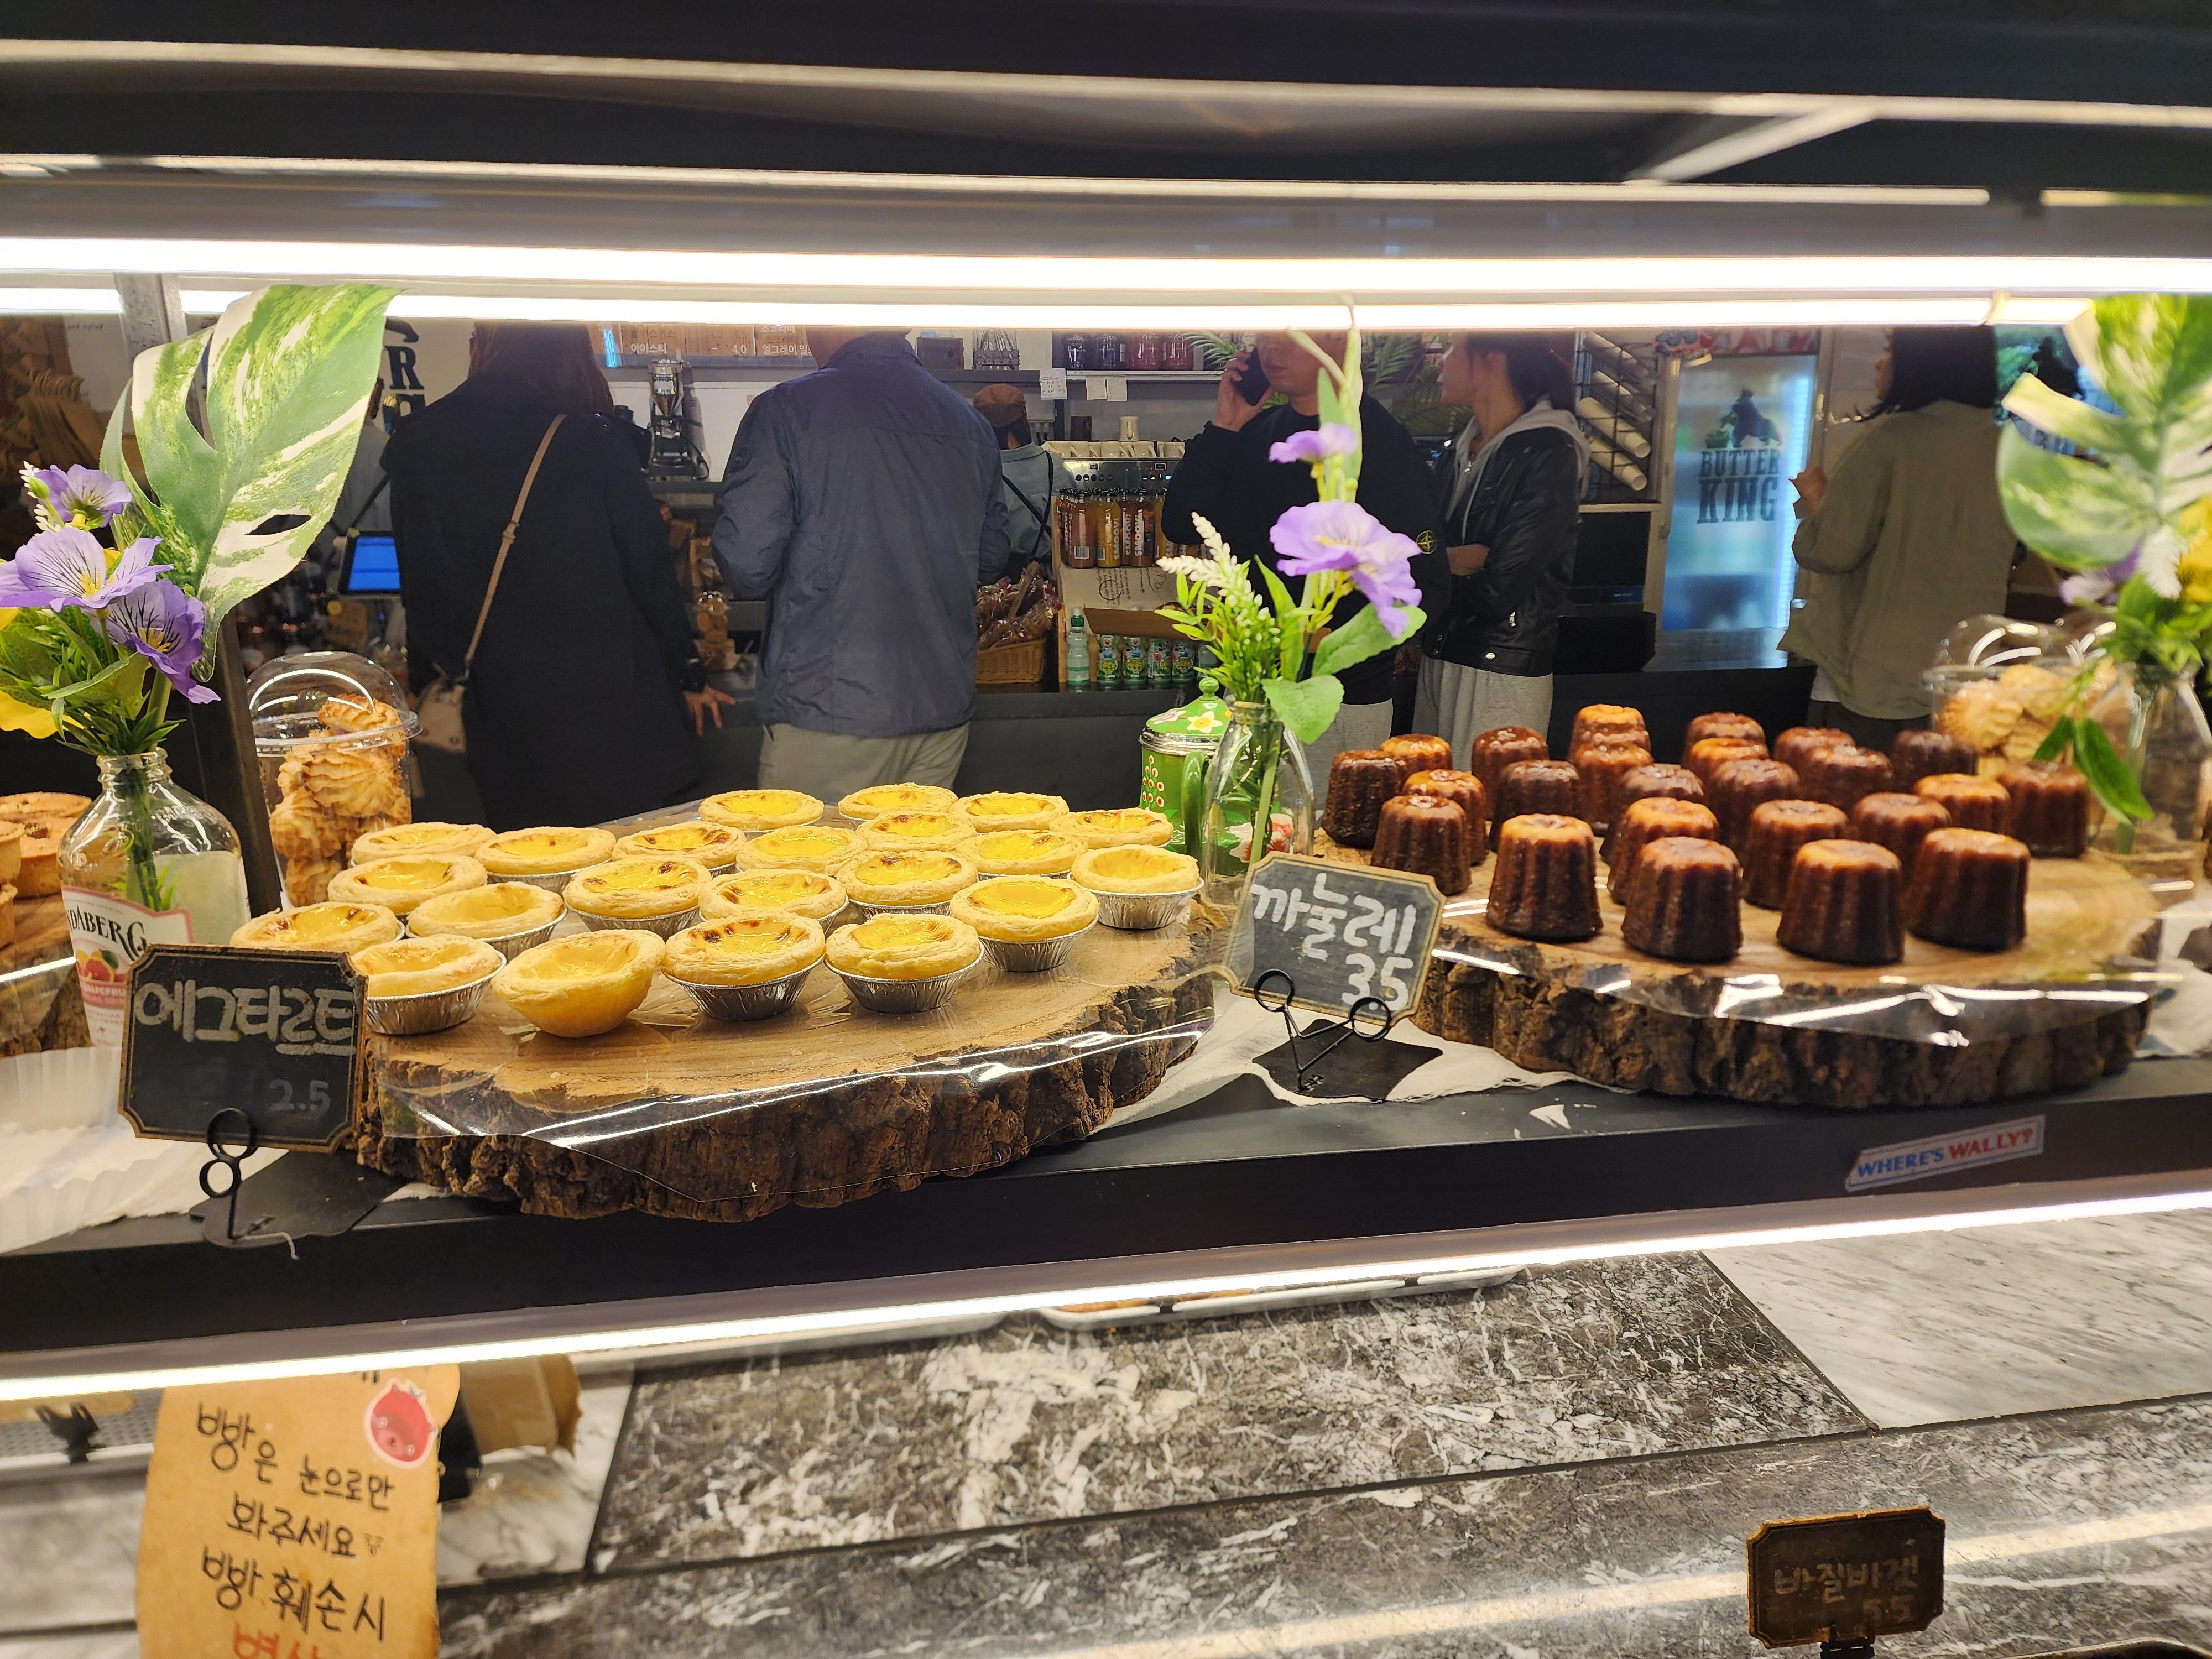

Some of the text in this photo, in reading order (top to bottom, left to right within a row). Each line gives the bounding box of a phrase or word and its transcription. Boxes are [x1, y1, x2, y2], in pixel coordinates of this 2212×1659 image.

[631, 343, 747, 354] 아이스티 4.0
[762, 345, 798, 356] 얼그레이
[1699, 449, 1780, 477] BUTTER
[1697, 477, 1778, 524] KING
[1250, 873, 1417, 961] 까눌레
[134, 979, 357, 1056] 에그타르트
[269, 1079, 331, 1113] 2.5
[1856, 1128, 2034, 1178] WHERE'S WALLY?
[196, 1400, 395, 1512] 빵은 눈으로만
[225, 1491, 357, 1558] 봐주세요
[201, 1544, 263, 1611] 빵
